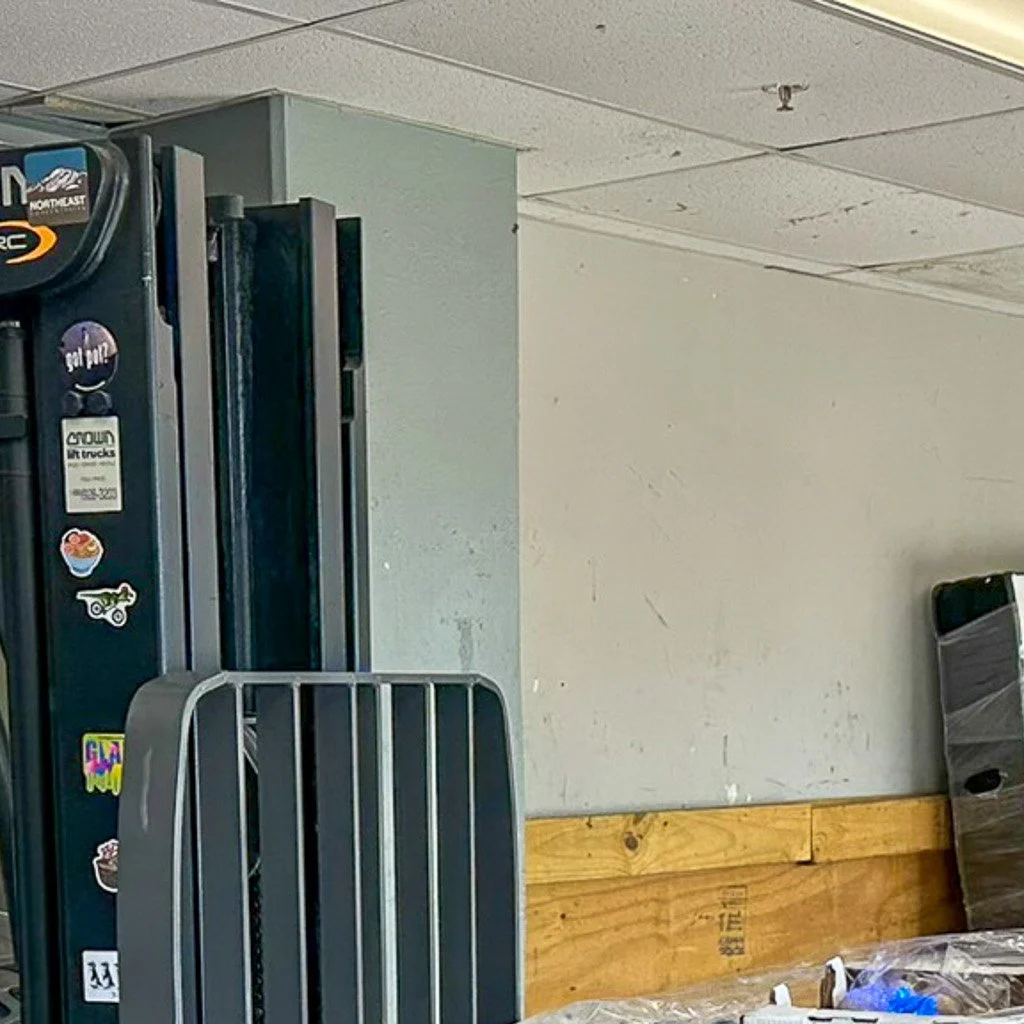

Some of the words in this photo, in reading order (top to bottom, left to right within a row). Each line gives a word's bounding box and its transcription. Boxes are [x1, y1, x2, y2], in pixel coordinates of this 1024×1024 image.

[30, 196, 86, 213] NORTHEAST
[67, 449, 80, 459] lift
[82, 448, 115, 459] trucks
